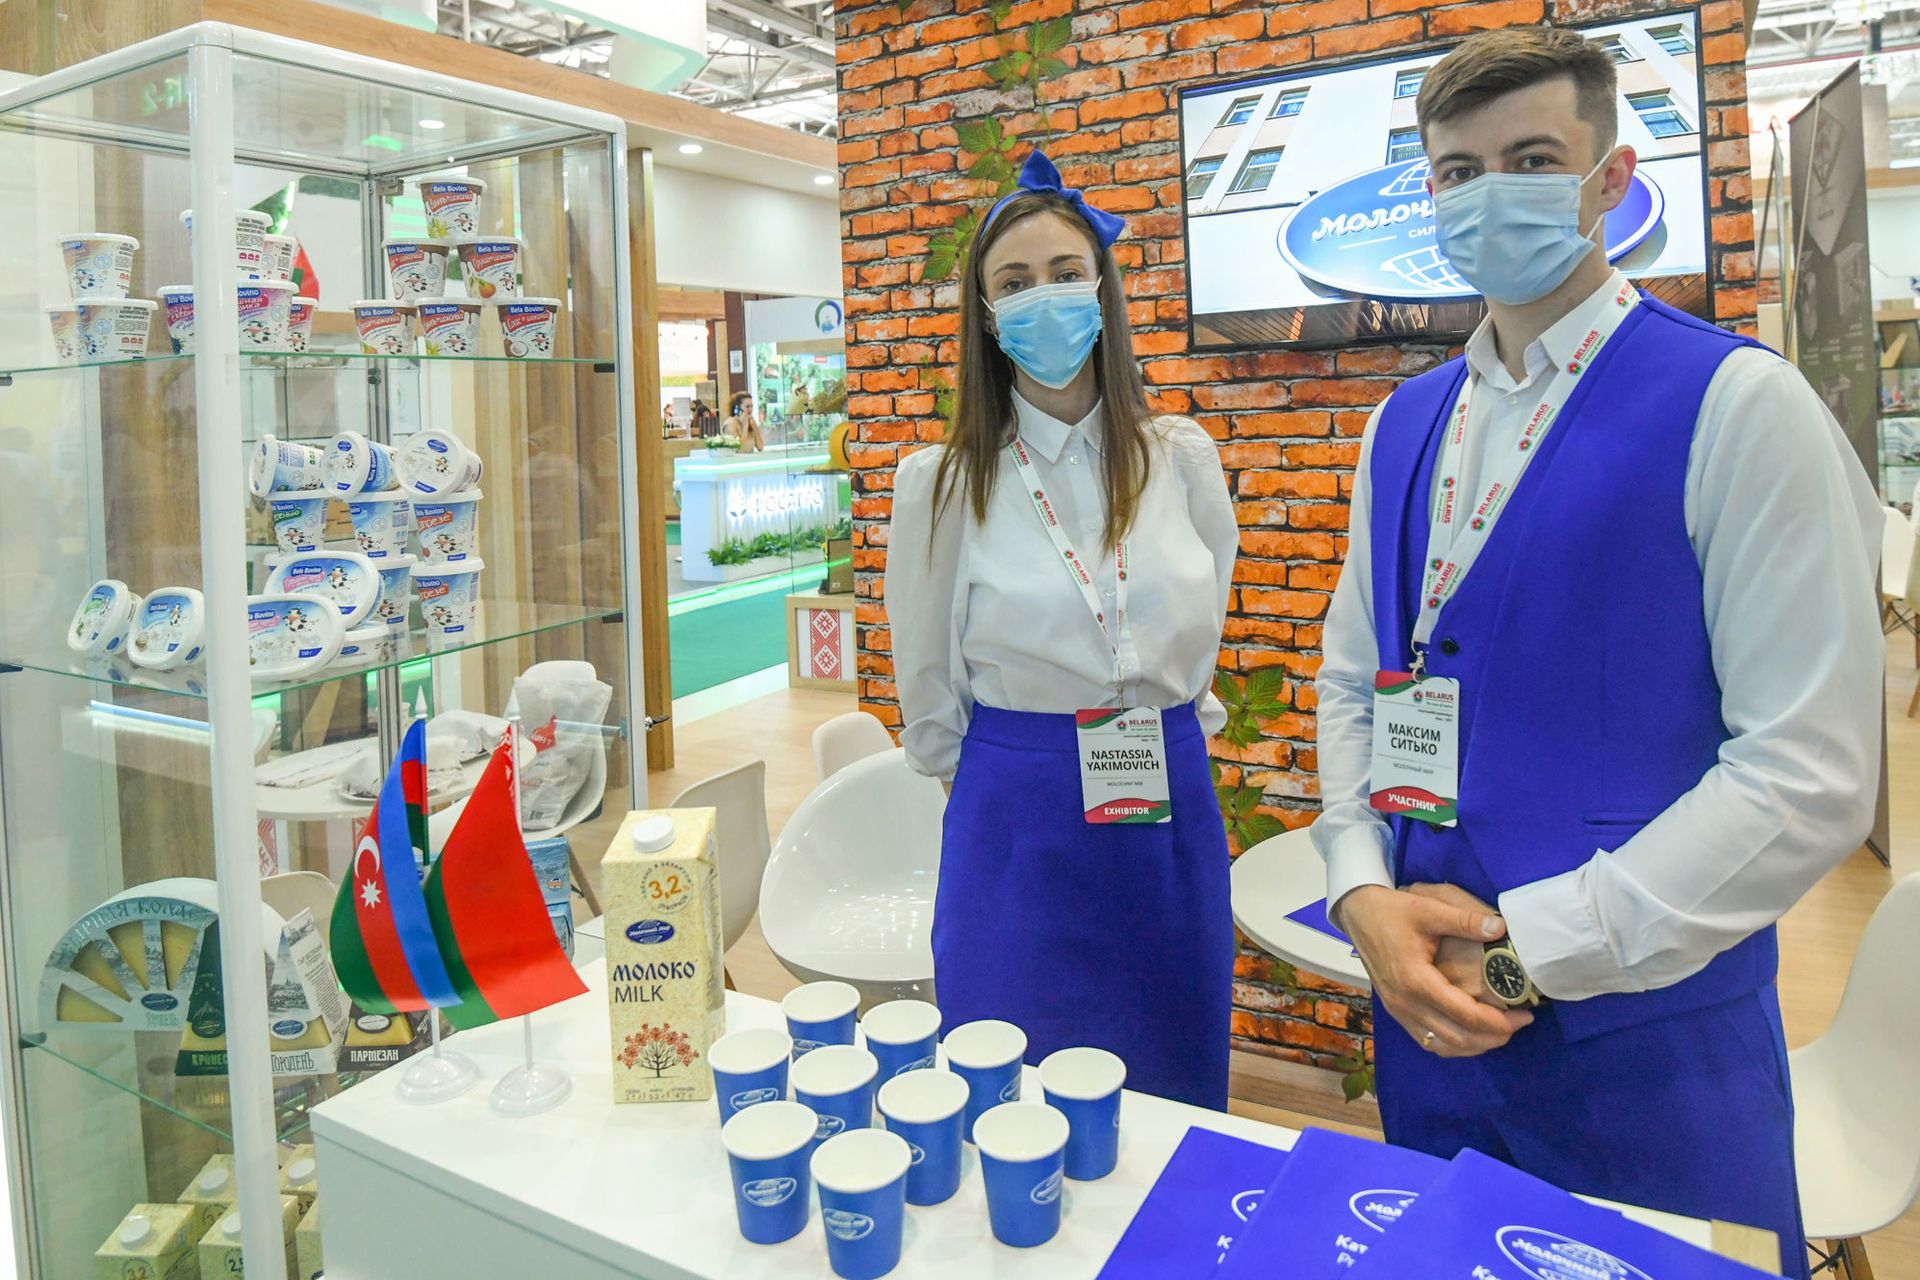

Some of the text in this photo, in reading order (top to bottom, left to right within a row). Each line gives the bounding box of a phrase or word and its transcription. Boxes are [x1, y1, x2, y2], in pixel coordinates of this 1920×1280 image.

[1312, 199, 1436, 241] Молоч
[179, 295, 194, 303] Bov
[237, 289, 259, 297] ovino
[1573, 329, 1599, 360] BELARUS
[1525, 402, 1548, 436] BELARUS
[1015, 441, 1029, 466] BELARUS
[1443, 490, 1454, 524] BELARUS
[1477, 482, 1501, 516] BELARUS
[1042, 500, 1057, 526] BELARUS
[1073, 559, 1090, 585] BELARUS
[1432, 561, 1455, 595] BELARUS
[1425, 690, 1454, 701] BELARUS
[1388, 722, 1441, 742] МАКСИМ
[1092, 750, 1153, 760] NASTASSIA
[1391, 737, 1438, 756] СИТЬКО
[1087, 761, 1160, 771] YAKIMOVICH
[1104, 807, 1150, 815] EXHIBITOR
[1388, 793, 1437, 812] УЧАСТНИК
[613, 961, 695, 982] МОЛОКО
[615, 984, 664, 1003] MILK
[351, 1049, 399, 1062] ПАРМЕЗАН
